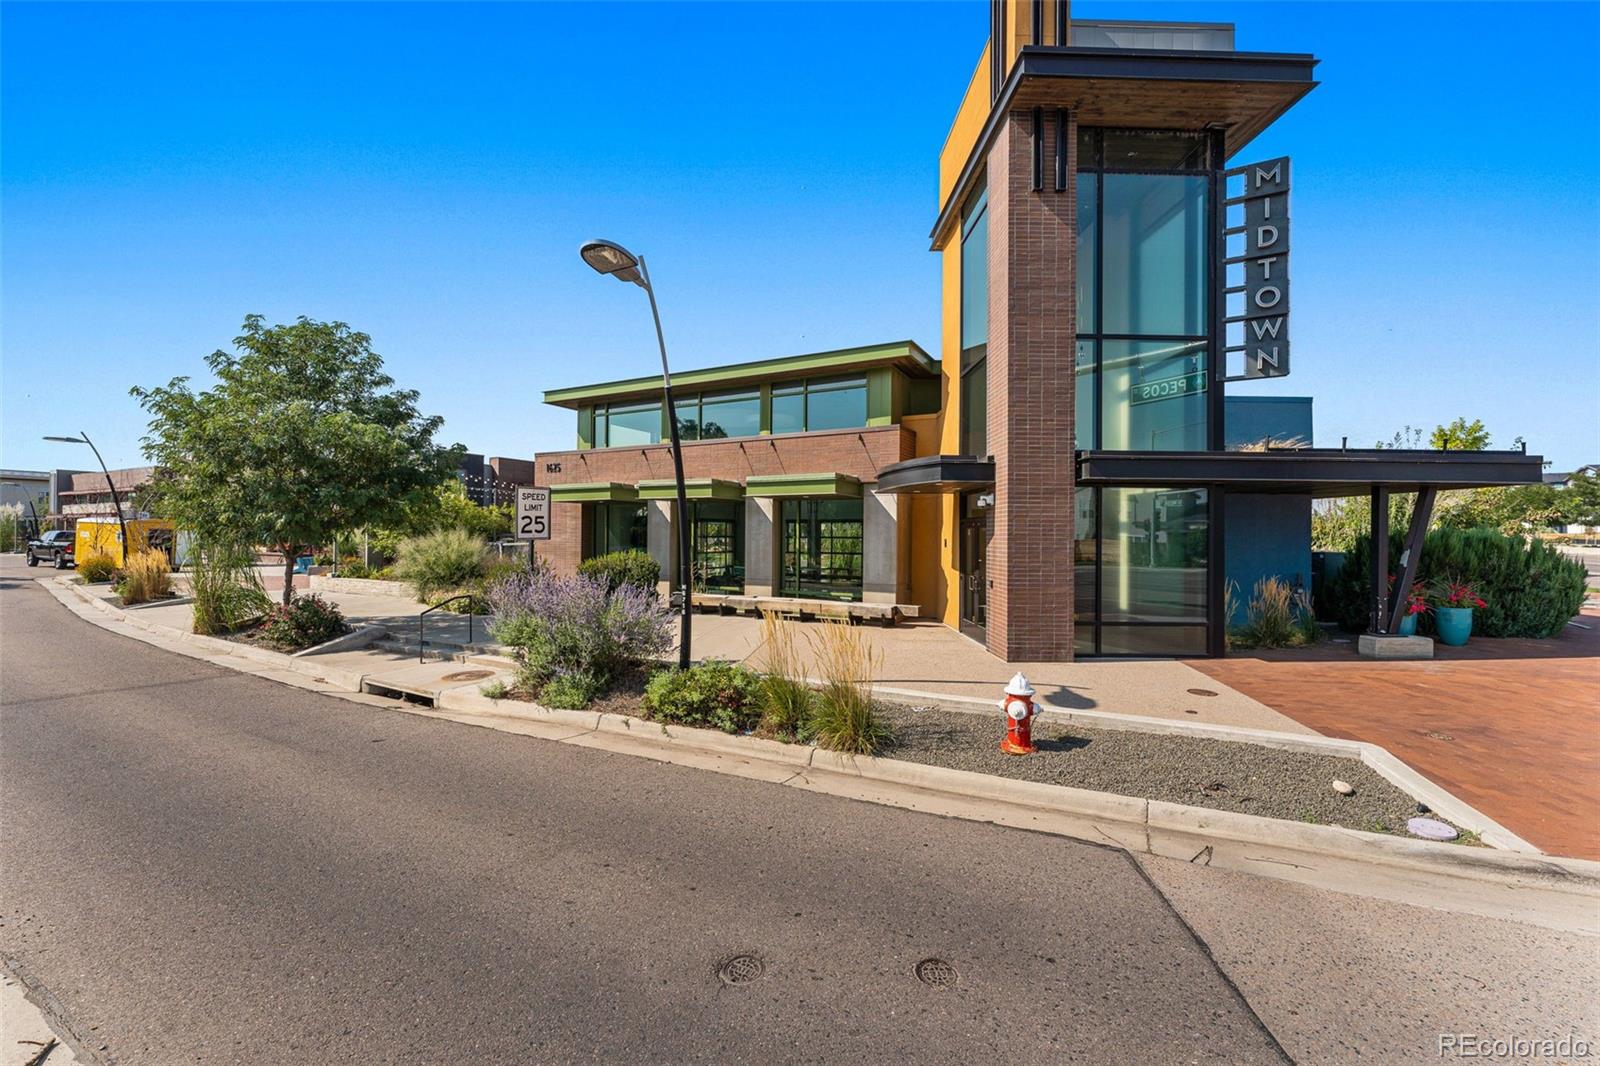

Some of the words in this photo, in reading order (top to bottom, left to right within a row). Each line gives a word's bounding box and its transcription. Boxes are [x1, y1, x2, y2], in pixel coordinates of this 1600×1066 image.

[1252, 162, 1283, 370] MIDTOWN
[521, 492, 546, 501] SPEED
[524, 503, 543, 512] LIMIT
[521, 515, 546, 534] 25
